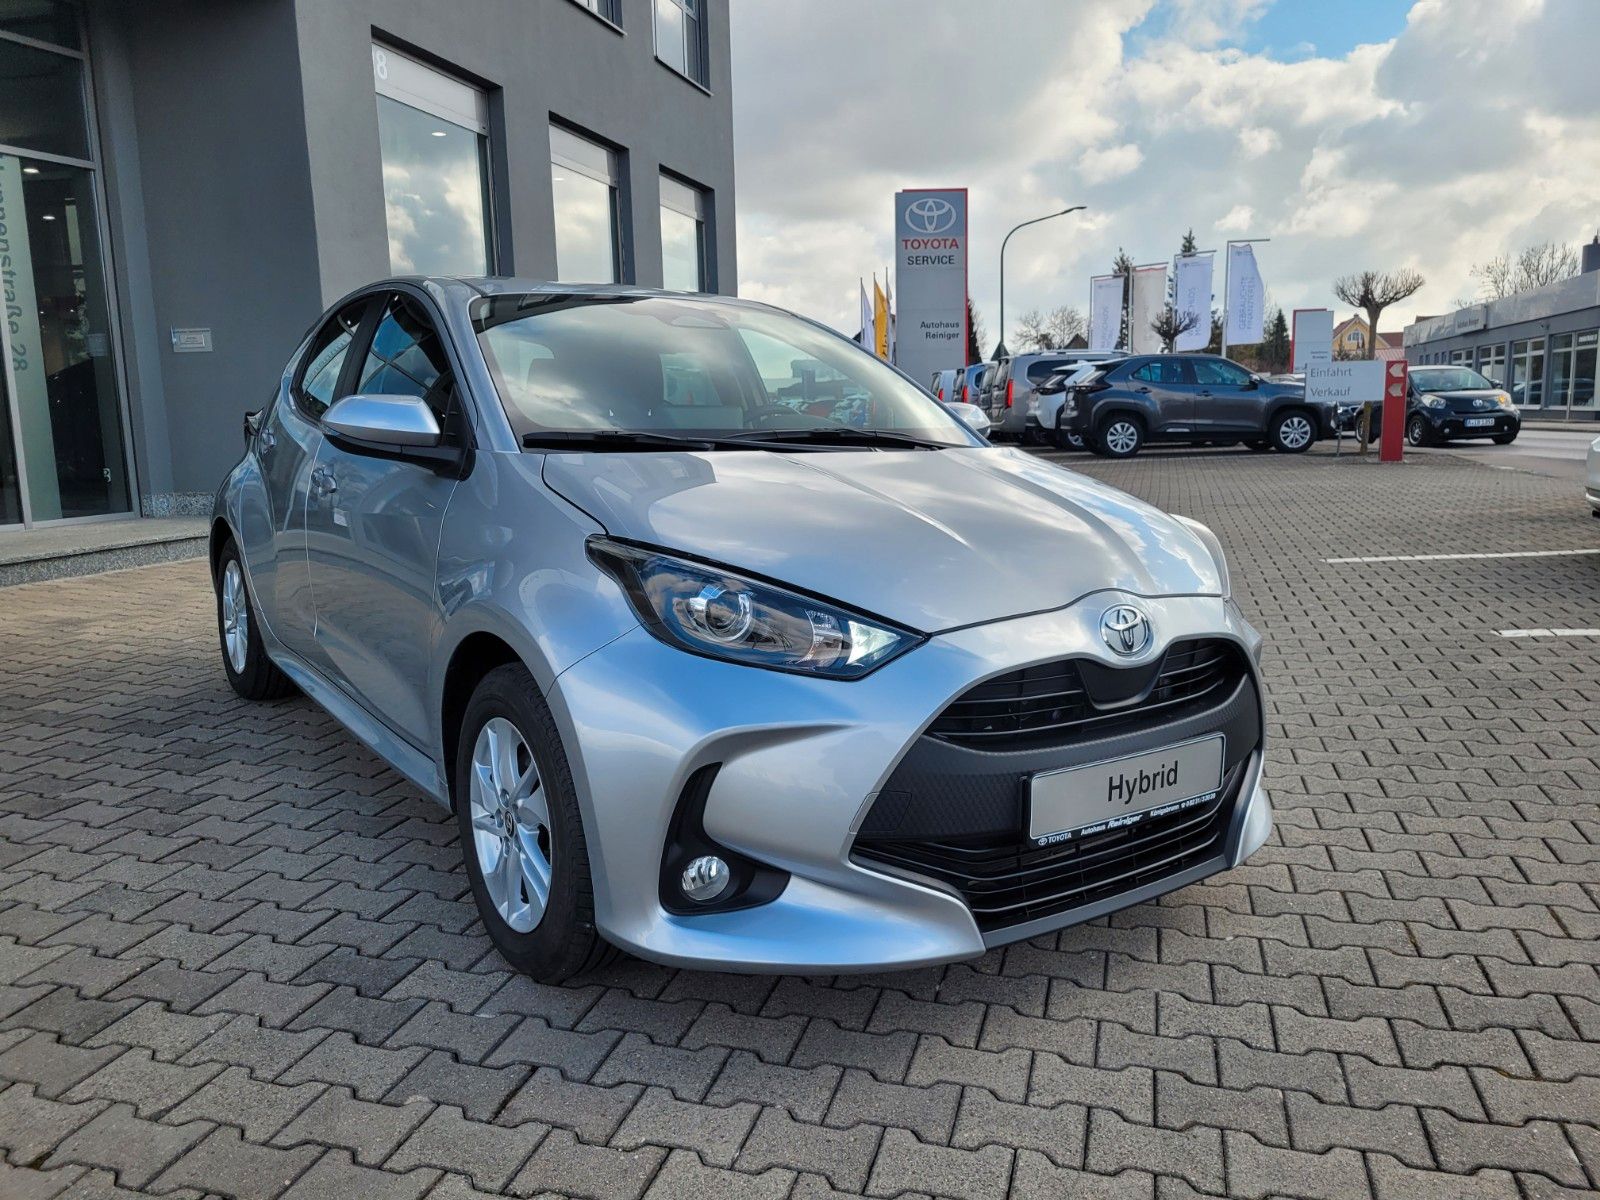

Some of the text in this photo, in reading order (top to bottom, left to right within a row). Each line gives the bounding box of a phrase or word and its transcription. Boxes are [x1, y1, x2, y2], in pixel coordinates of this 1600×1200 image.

[902, 238, 960, 250] TOYOTA
[907, 254, 955, 266] SERVICE
[920, 320, 960, 330] Autohaus
[925, 331, 960, 341] Reiniger
[1310, 367, 1352, 378] Einfahrt
[1310, 387, 1351, 397] Verkauf
[1107, 760, 1179, 805] Hybrid
[1048, 832, 1072, 844] TOYOTA
[1080, 824, 1106, 836] Autohaus
[1107, 814, 1143, 829] Reiniger
